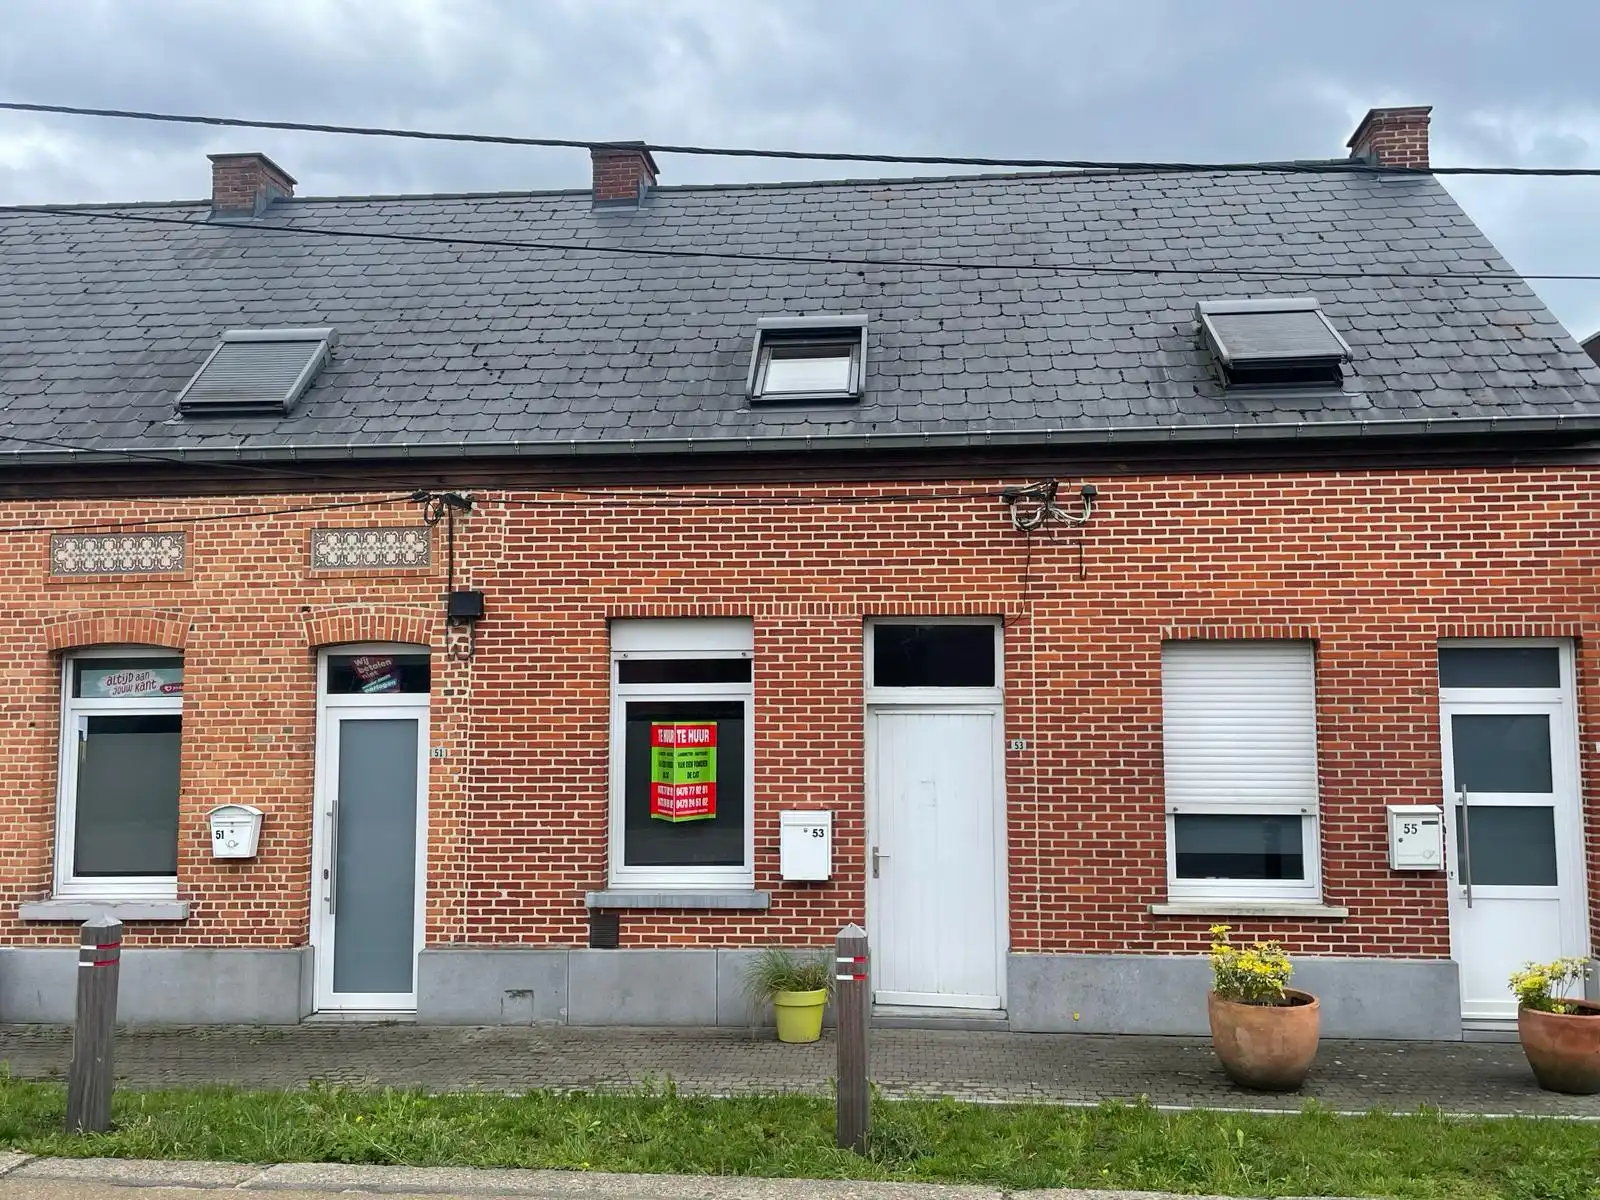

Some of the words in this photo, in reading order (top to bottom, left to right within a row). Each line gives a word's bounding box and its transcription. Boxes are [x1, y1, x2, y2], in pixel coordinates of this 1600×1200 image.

[676, 728, 687, 744] TE
[688, 728, 710, 743] HUUR
[1014, 741, 1024, 750] 53
[434, 748, 443, 757] 51
[689, 785, 696, 795] 77
[812, 828, 825, 838] 53
[1403, 823, 1418, 835] 55
[215, 830, 225, 840] 51
